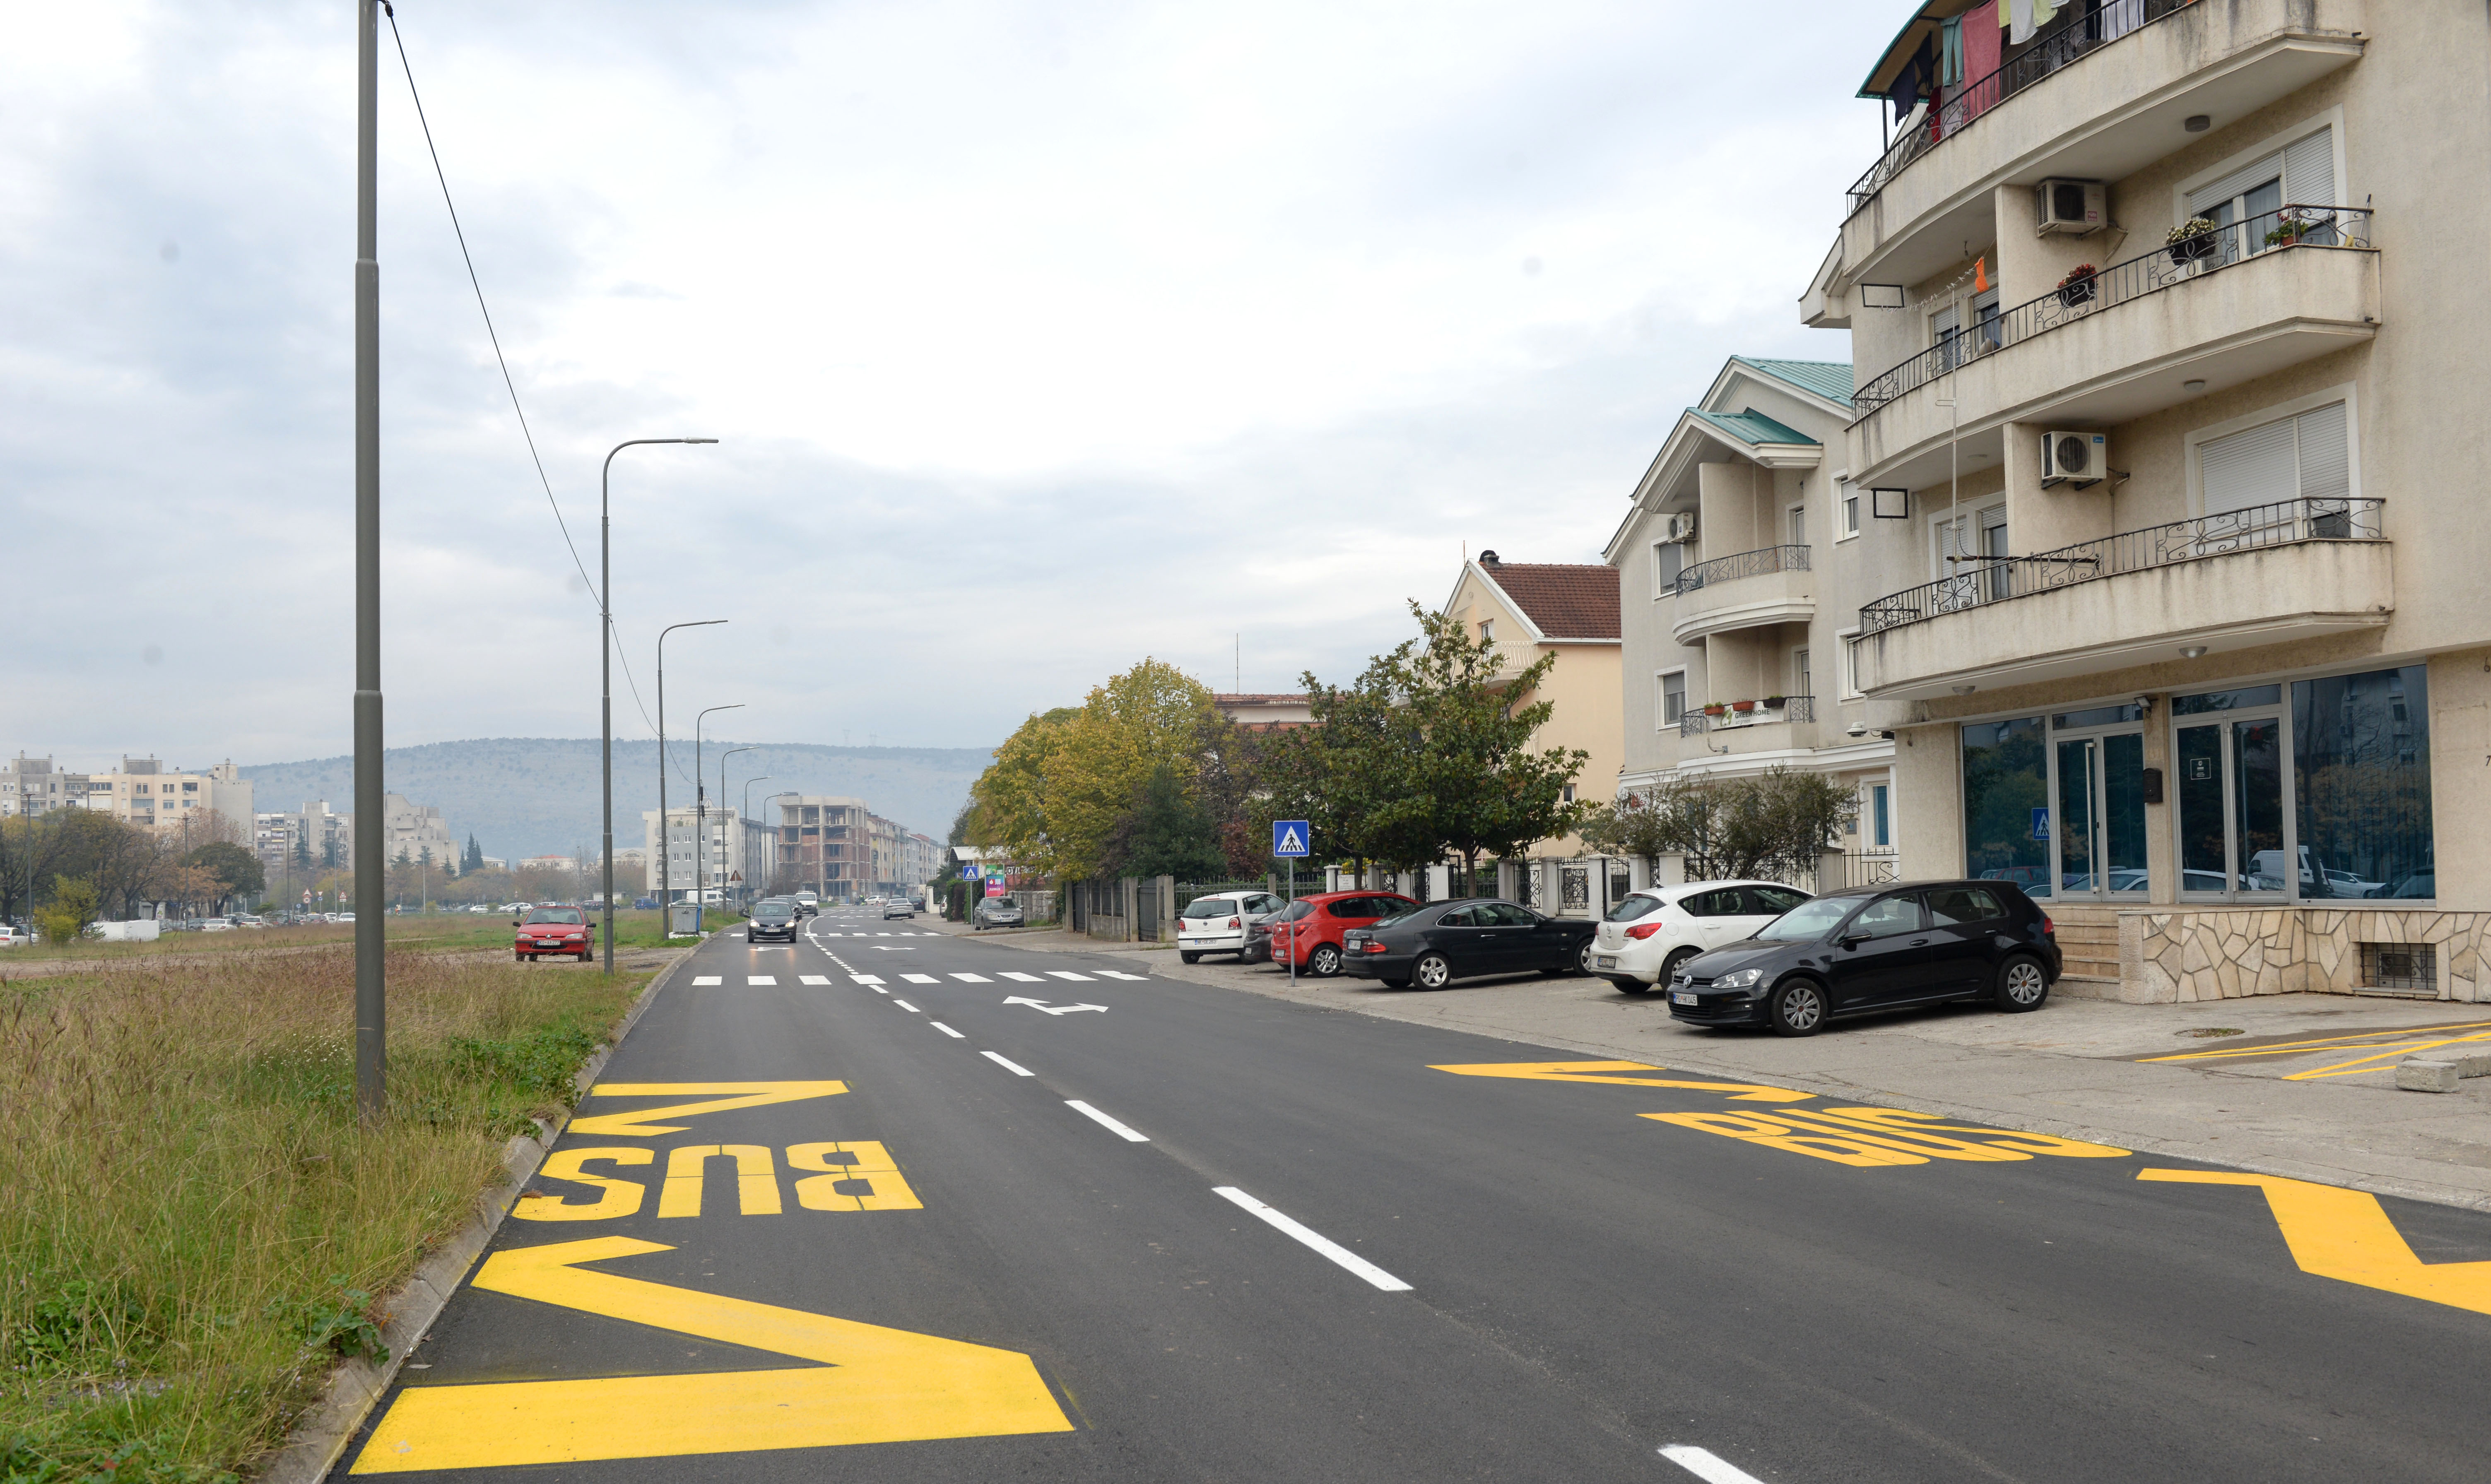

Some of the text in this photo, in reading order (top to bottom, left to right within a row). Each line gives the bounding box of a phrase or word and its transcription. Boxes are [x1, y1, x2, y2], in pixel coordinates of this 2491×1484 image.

[1676, 994, 1681, 1003] PG
[1636, 1107, 2132, 1167] BUS
[512, 1140, 924, 1221] BUS
